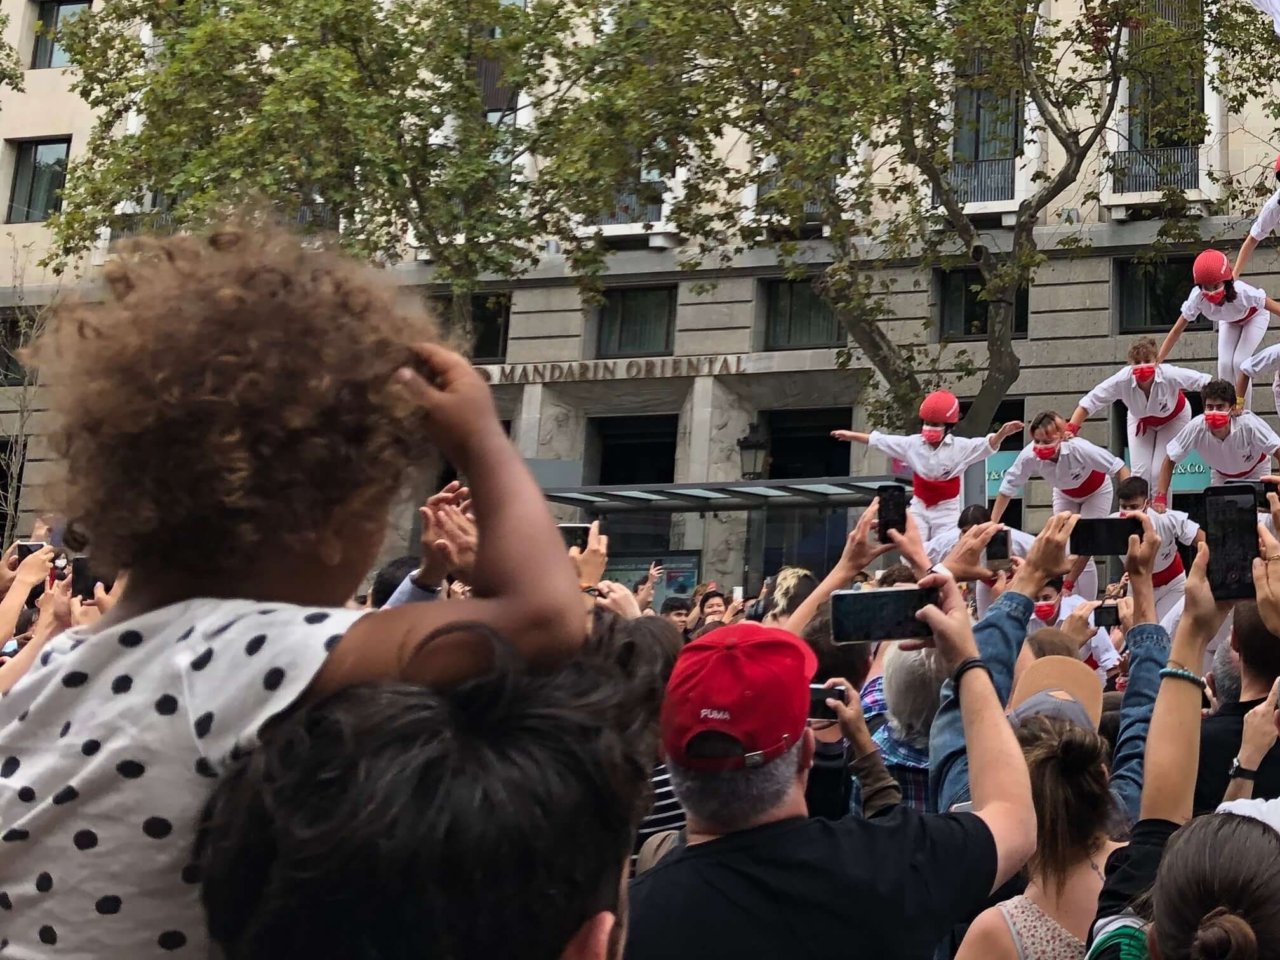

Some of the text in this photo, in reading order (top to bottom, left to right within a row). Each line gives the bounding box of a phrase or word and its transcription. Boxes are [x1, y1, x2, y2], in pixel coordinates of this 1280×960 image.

[499, 355, 747, 383] MANDARIN ORIENTAL
[700, 708, 731, 720] PUMA
